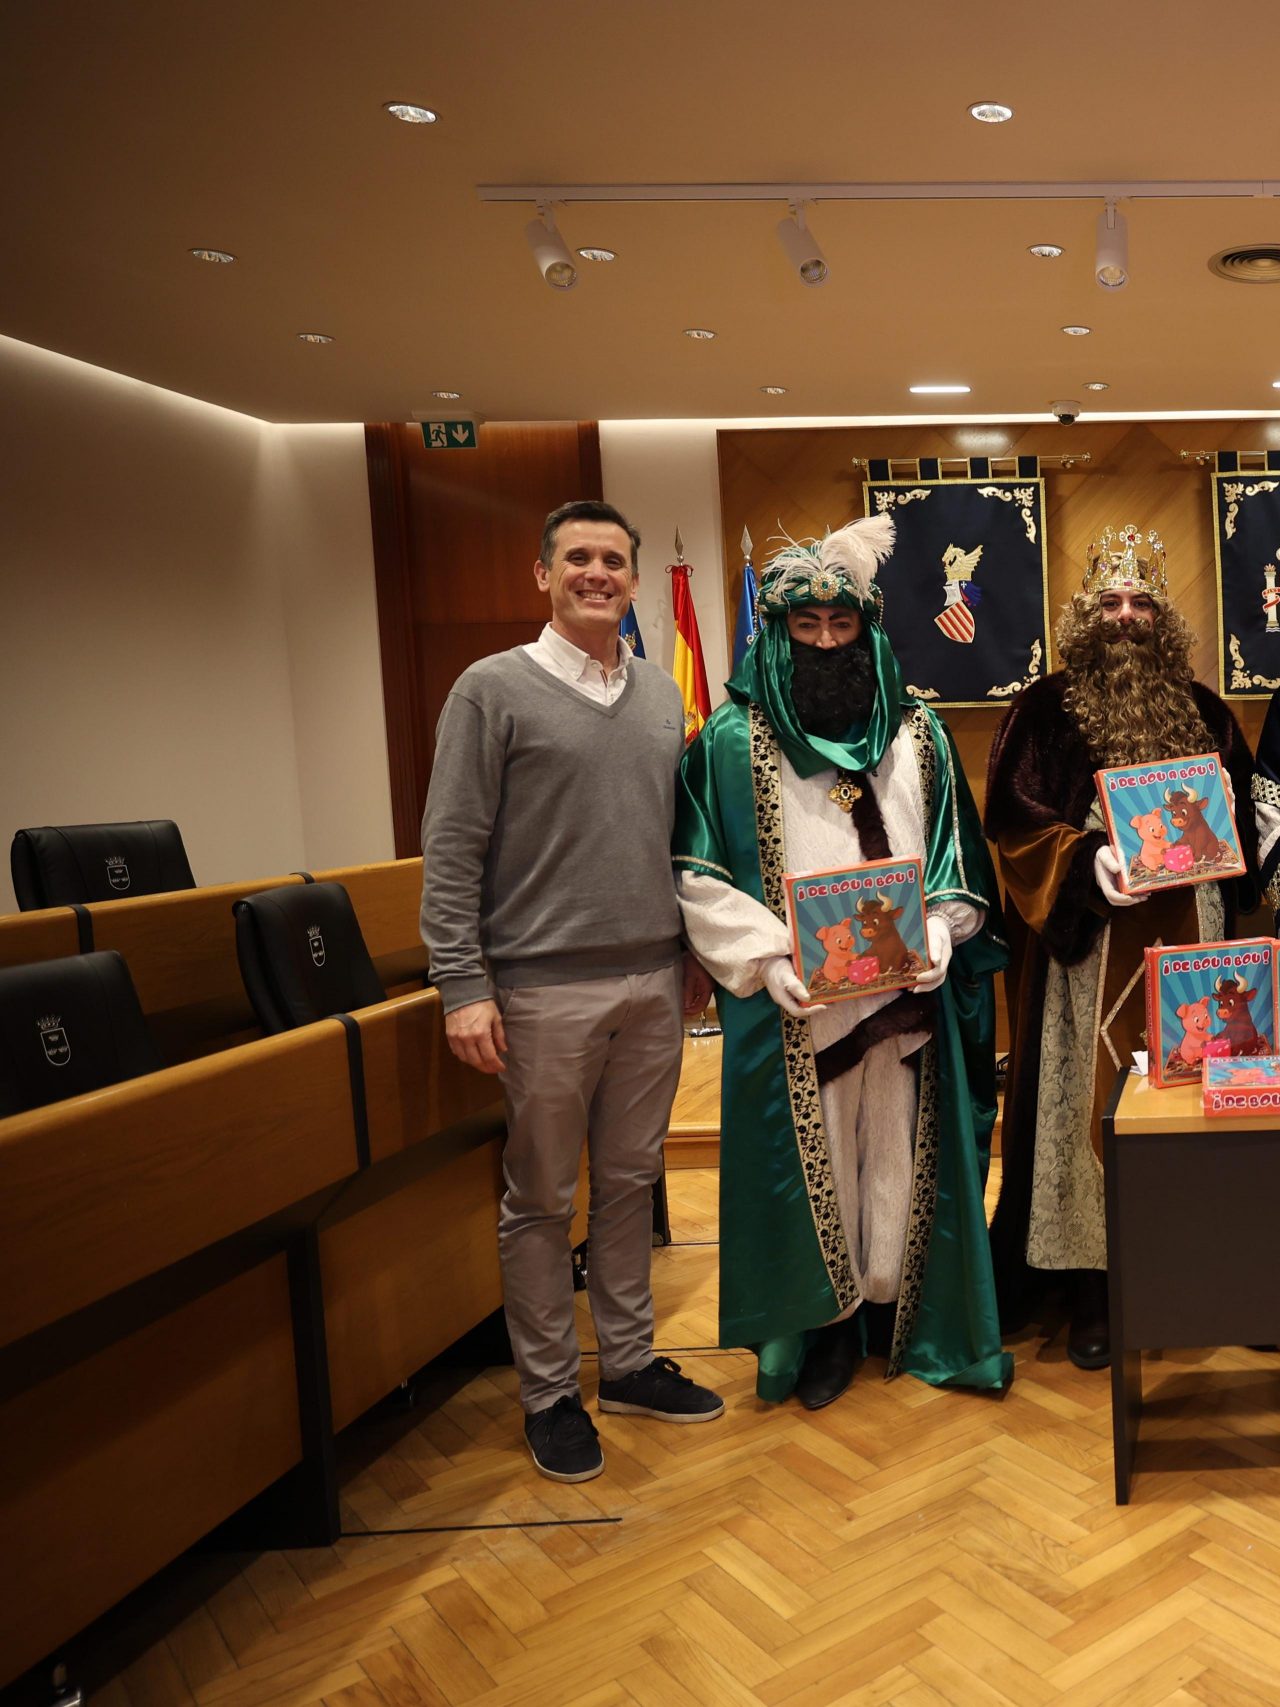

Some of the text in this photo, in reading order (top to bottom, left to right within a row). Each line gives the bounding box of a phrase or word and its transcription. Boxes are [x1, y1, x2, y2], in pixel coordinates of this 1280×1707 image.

[1138, 770, 1167, 785] BOU
[1168, 770, 1178, 781] A
[830, 880, 861, 895] BOU
[864, 878, 873, 888] A
[1193, 957, 1221, 971] BOU
[1222, 956, 1232, 967] A
